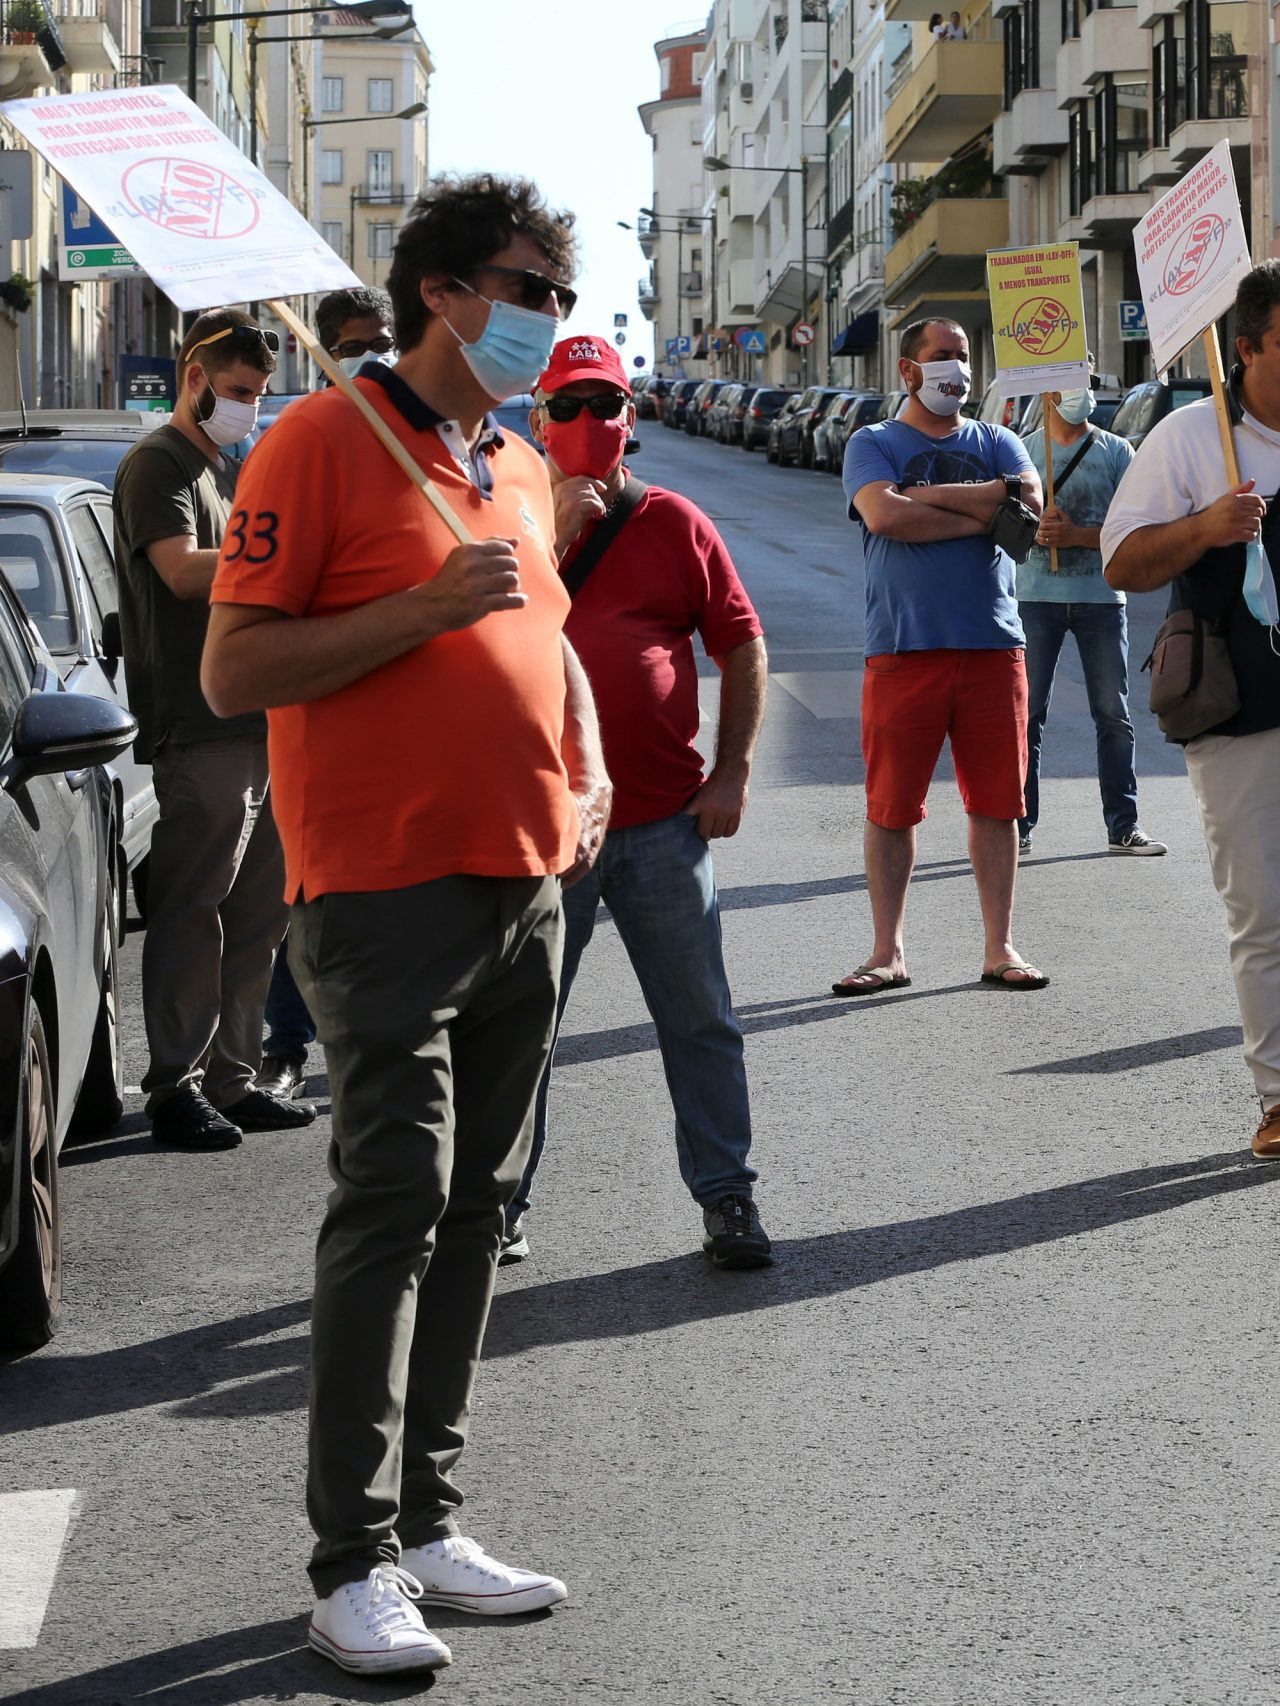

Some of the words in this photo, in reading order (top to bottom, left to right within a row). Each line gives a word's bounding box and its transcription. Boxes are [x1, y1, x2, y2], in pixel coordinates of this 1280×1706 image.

[31, 104, 71, 120] MAIS
[70, 94, 167, 117] TRANSPORTES
[38, 124, 79, 139] PARA
[82, 116, 145, 135] GARANTIR
[144, 111, 192, 127] MAIOR
[130, 134, 160, 149] DOS
[157, 129, 219, 147] UTENTES
[1146, 206, 1165, 229] MAIS
[1165, 158, 1214, 210] TRANSPORTES
[1182, 204, 1197, 223] DOS
[1197, 174, 1228, 208] UTENTES
[1143, 225, 1162, 247] PARA
[1162, 190, 1197, 228] GARANTIR
[1197, 166, 1221, 194] MAIOR
[990, 253, 1035, 267] TRABALHADOR
[1035, 252, 1044, 262] EM
[1024, 265, 1043, 275] IGUAL
[999, 281, 1004, 290] A
[1004, 279, 1026, 290] MENOS
[1027, 274, 1071, 288] TRANSPORTES
[1124, 305, 1138, 323] P
[568, 349, 601, 359] LABA
[677, 338, 688, 350] P
[223, 510, 280, 564] 33
